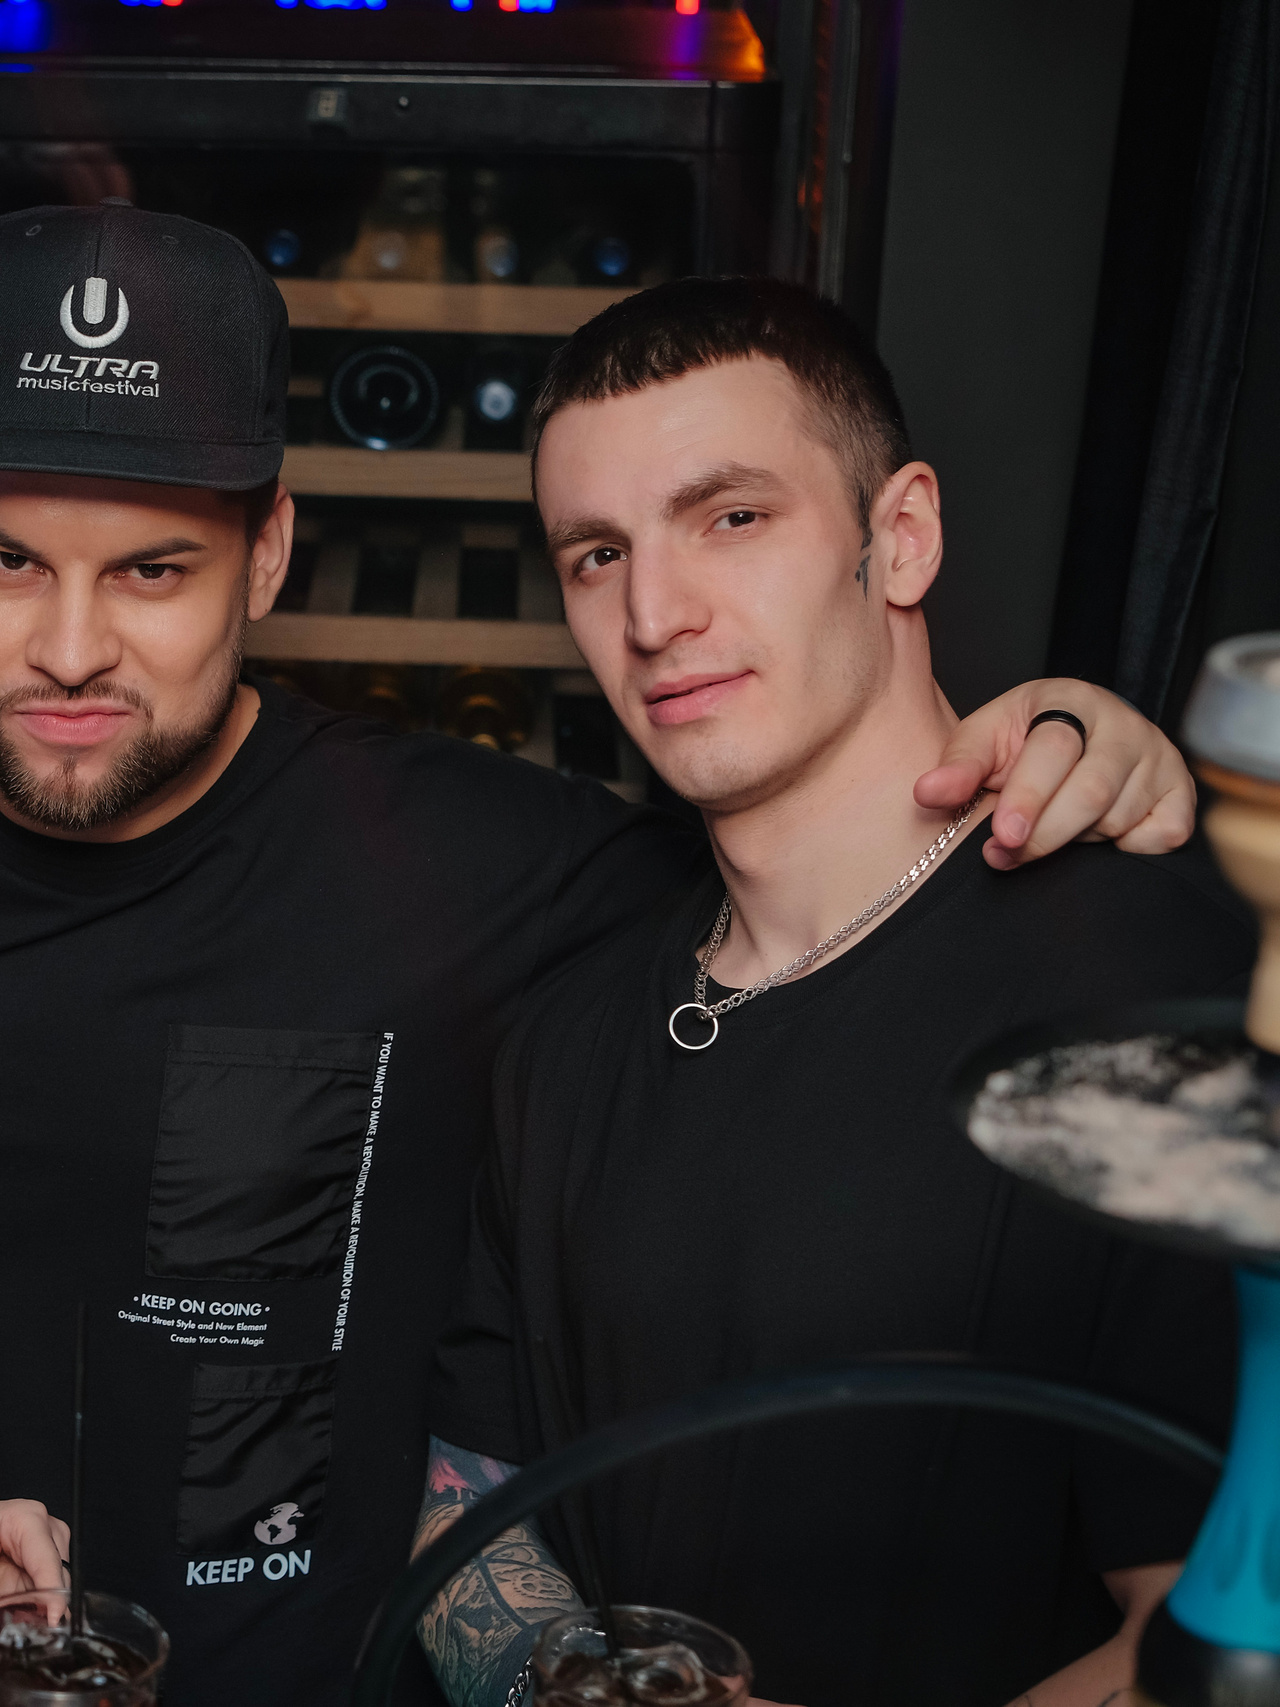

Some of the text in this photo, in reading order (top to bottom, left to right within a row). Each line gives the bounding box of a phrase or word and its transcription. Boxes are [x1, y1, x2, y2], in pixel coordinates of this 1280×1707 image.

[19, 352, 160, 381] ULTRA
[15, 375, 160, 398] musicfestival
[383, 1031, 395, 1041] IF
[378, 1042, 393, 1063] YOU
[372, 1064, 388, 1094] WANT
[371, 1094, 383, 1109] TO
[366, 1110, 381, 1136] MAKE
[364, 1137, 374, 1145] A
[350, 1200, 363, 1226] MAKE
[349, 1226, 360, 1235] A
[341, 1234, 359, 1288] REVOLUTION
[140, 1293, 262, 1317] KEEP ON GOING
[340, 1288, 351, 1301] OF
[117, 1310, 268, 1332] Original Street Style and New Element
[335, 1301, 349, 1327] YOUR
[170, 1334, 265, 1347] Create Your Own Magic
[331, 1327, 345, 1352] STYLE
[185, 1549, 312, 1586] KEEP ON
